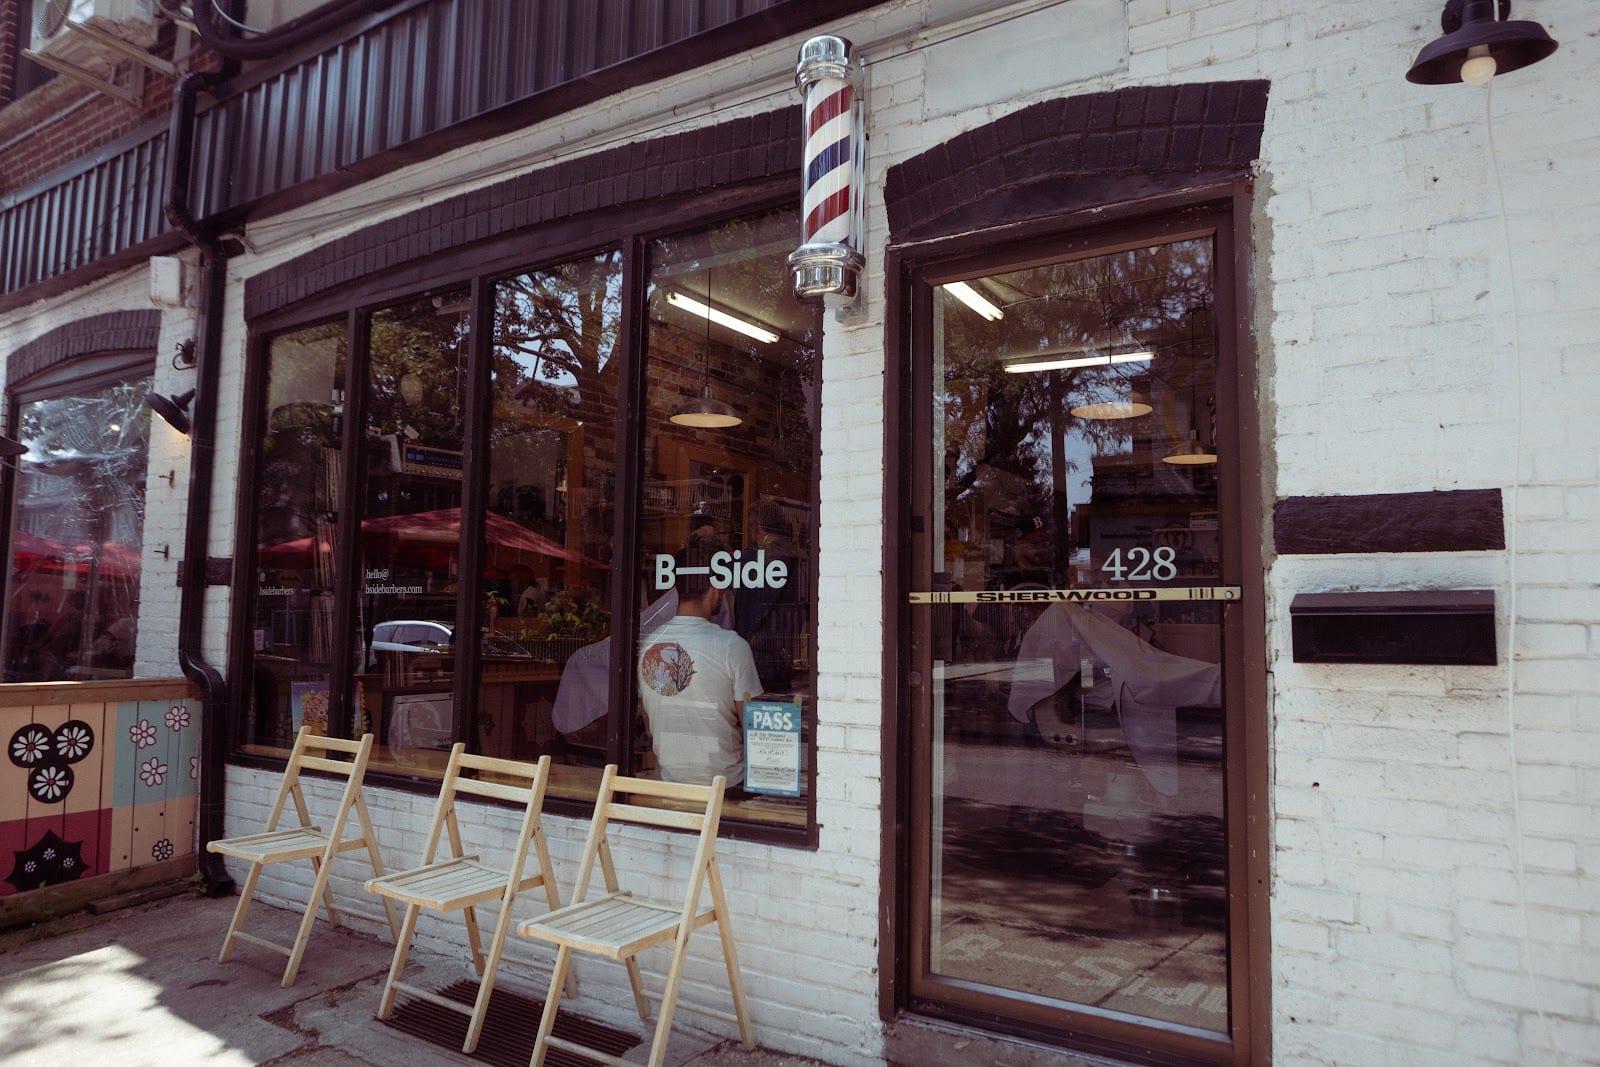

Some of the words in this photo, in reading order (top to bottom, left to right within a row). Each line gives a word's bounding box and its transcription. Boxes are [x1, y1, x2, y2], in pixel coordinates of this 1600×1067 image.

[1101, 546, 1177, 581] 428
[366, 568, 389, 581] hello@
[365, 583, 423, 595] bsidebarbers.com
[976, 589, 1157, 602] SHER-WOOD
[753, 711, 793, 731] PASS
